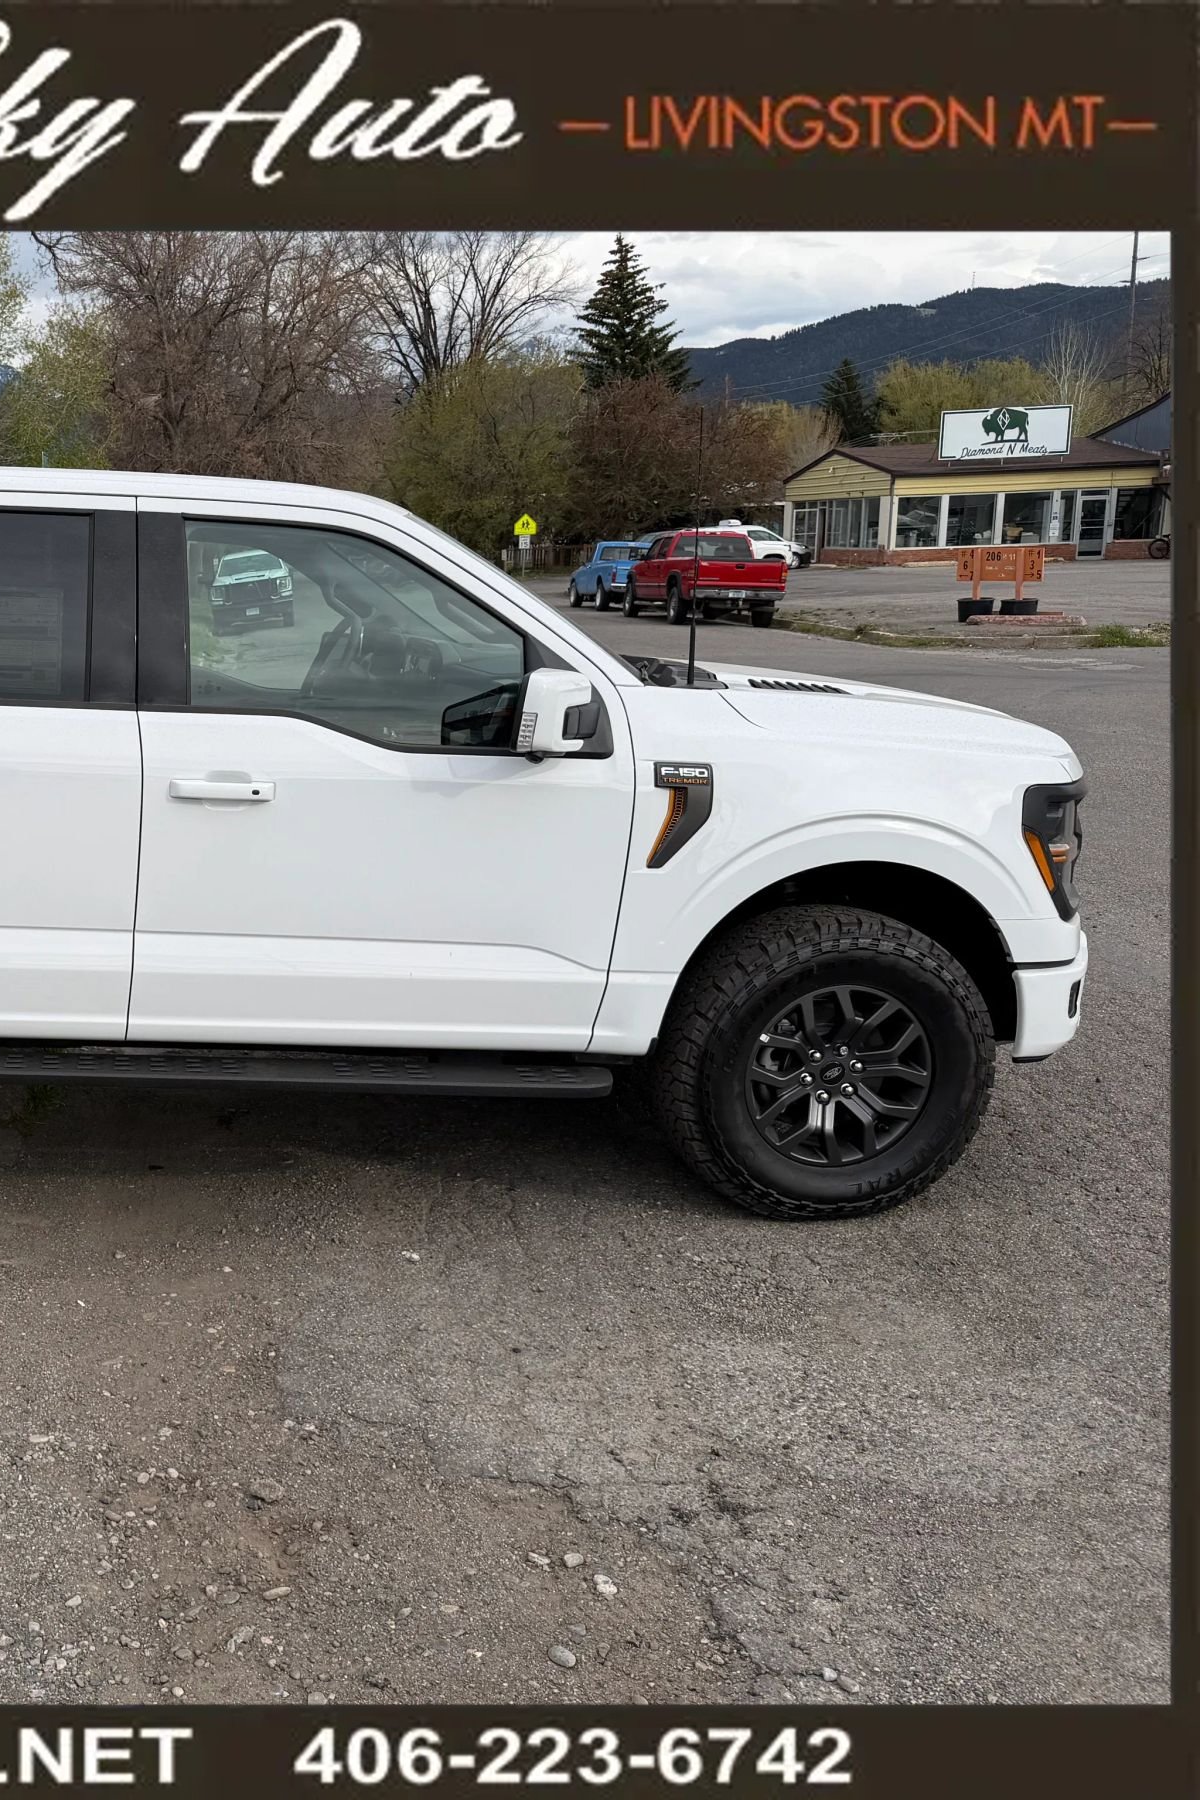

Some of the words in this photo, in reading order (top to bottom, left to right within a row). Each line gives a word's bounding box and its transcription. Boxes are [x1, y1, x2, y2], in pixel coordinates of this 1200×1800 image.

[960, 443, 1005, 459] Diamond
[1006, 443, 1018, 456] N
[1019, 442, 1049, 456] Meats
[985, 551, 1002, 561] 206
[661, 766, 708, 778] F-150
[663, 777, 707, 785] TREMOR
